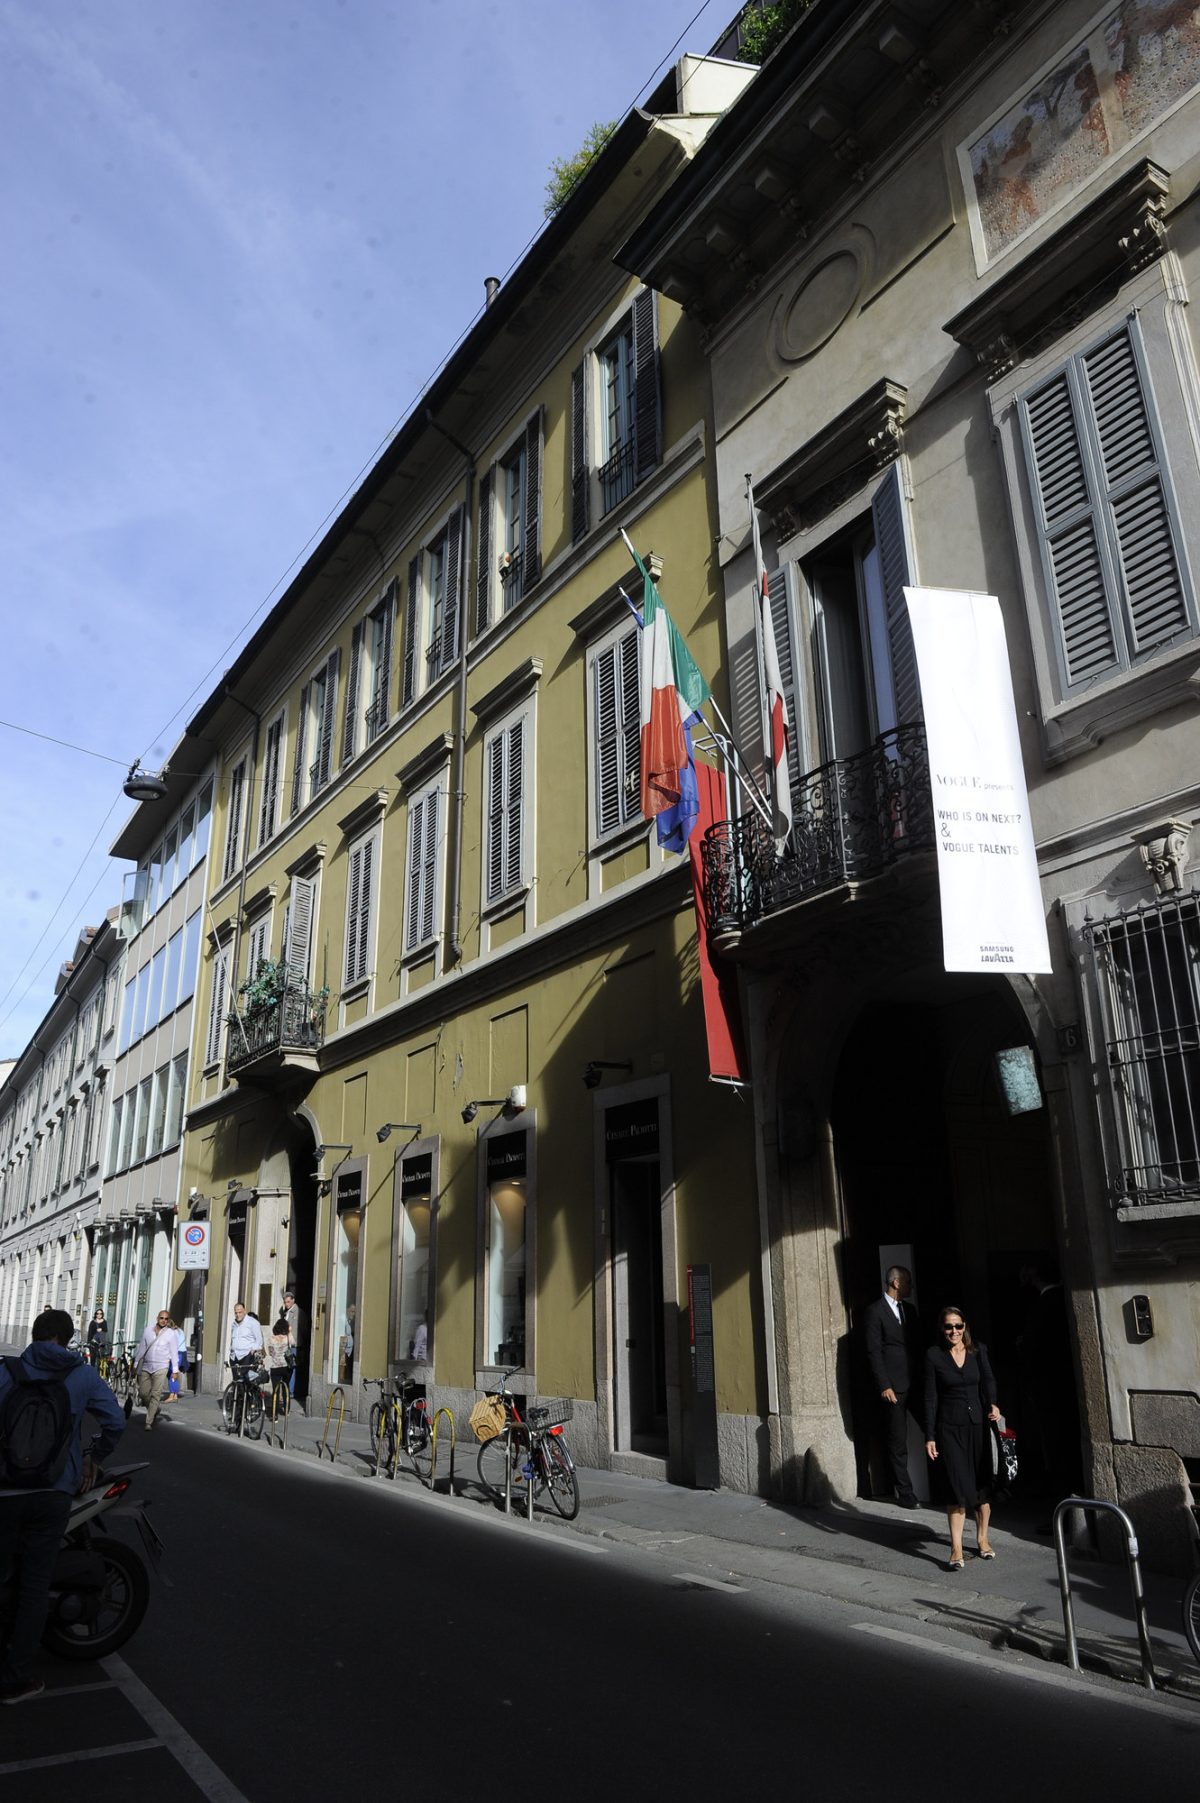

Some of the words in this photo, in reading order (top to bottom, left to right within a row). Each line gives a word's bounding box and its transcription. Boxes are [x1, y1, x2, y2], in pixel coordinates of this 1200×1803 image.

[937, 809, 959, 821] WHO
[962, 811, 972, 821] IS
[975, 811, 989, 822] ON
[991, 813, 1022, 824] NEXT?
[940, 822, 952, 838] &
[942, 841, 975, 853] VOGUE
[977, 843, 1020, 855] TALENTS
[981, 953, 1015, 963] LAVAZZA
[1065, 1028, 1076, 1047] 6
